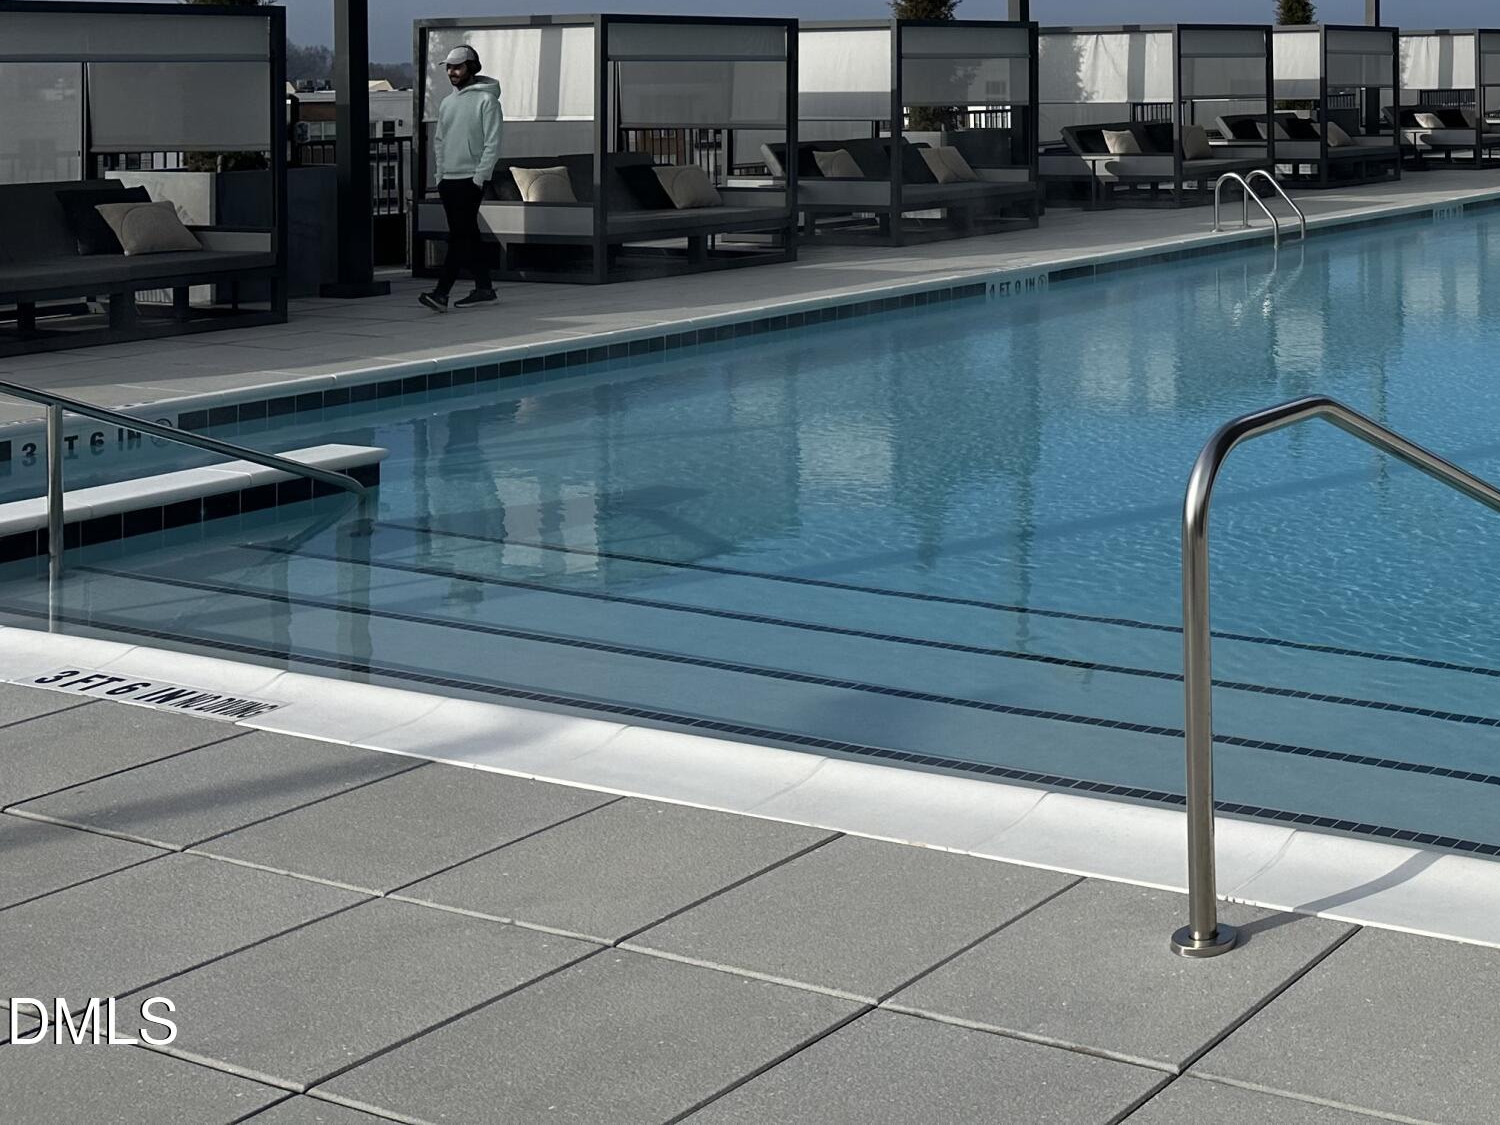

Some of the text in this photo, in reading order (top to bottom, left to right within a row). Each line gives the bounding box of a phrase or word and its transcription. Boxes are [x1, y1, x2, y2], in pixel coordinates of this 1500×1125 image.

[34, 670, 80, 684] 3
[58, 674, 127, 691] FT
[105, 682, 151, 695] 6
[133, 687, 198, 704] IN
